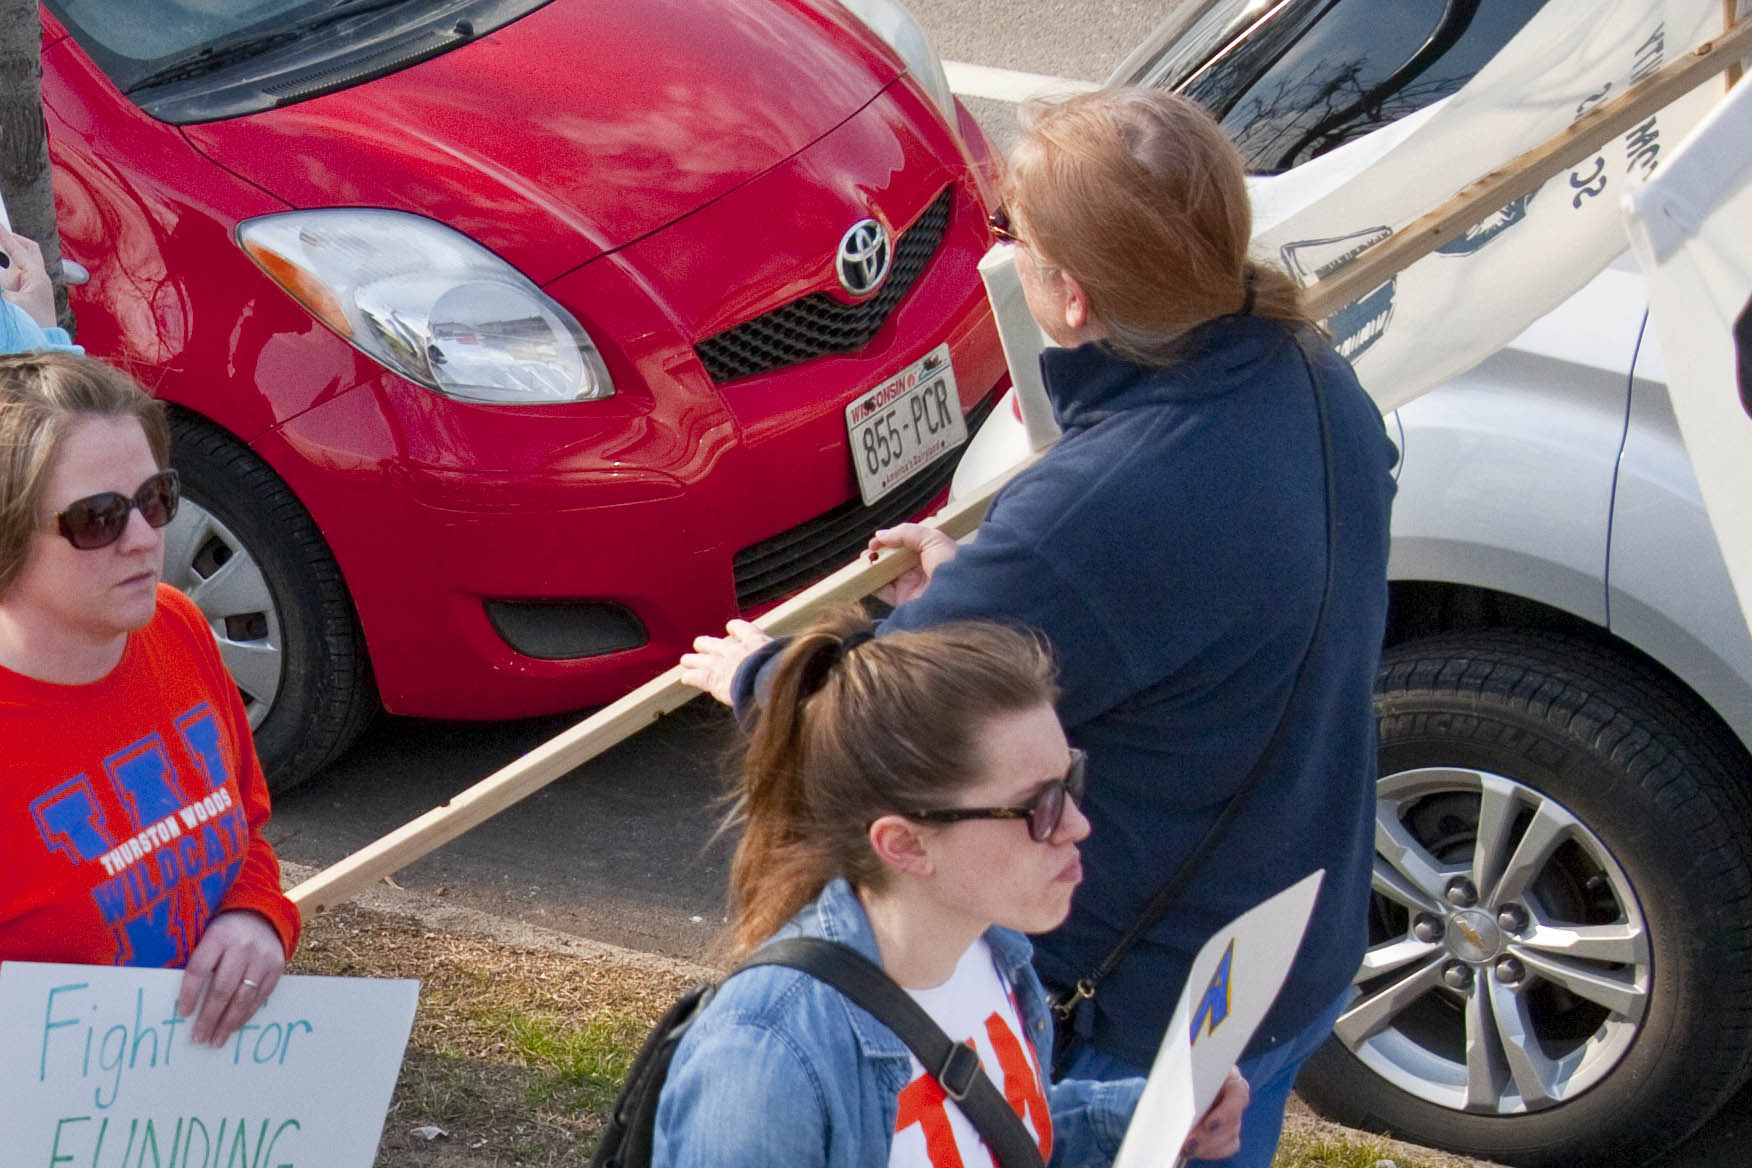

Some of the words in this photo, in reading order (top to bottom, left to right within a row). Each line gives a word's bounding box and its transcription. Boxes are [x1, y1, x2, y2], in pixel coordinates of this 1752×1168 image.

[862, 378, 952, 476] 855-PCR
[100, 816, 181, 875] THURSTON
[180, 787, 233, 830] WOODS
[40, 982, 186, 1109] Fight
[234, 1000, 313, 1065] for
